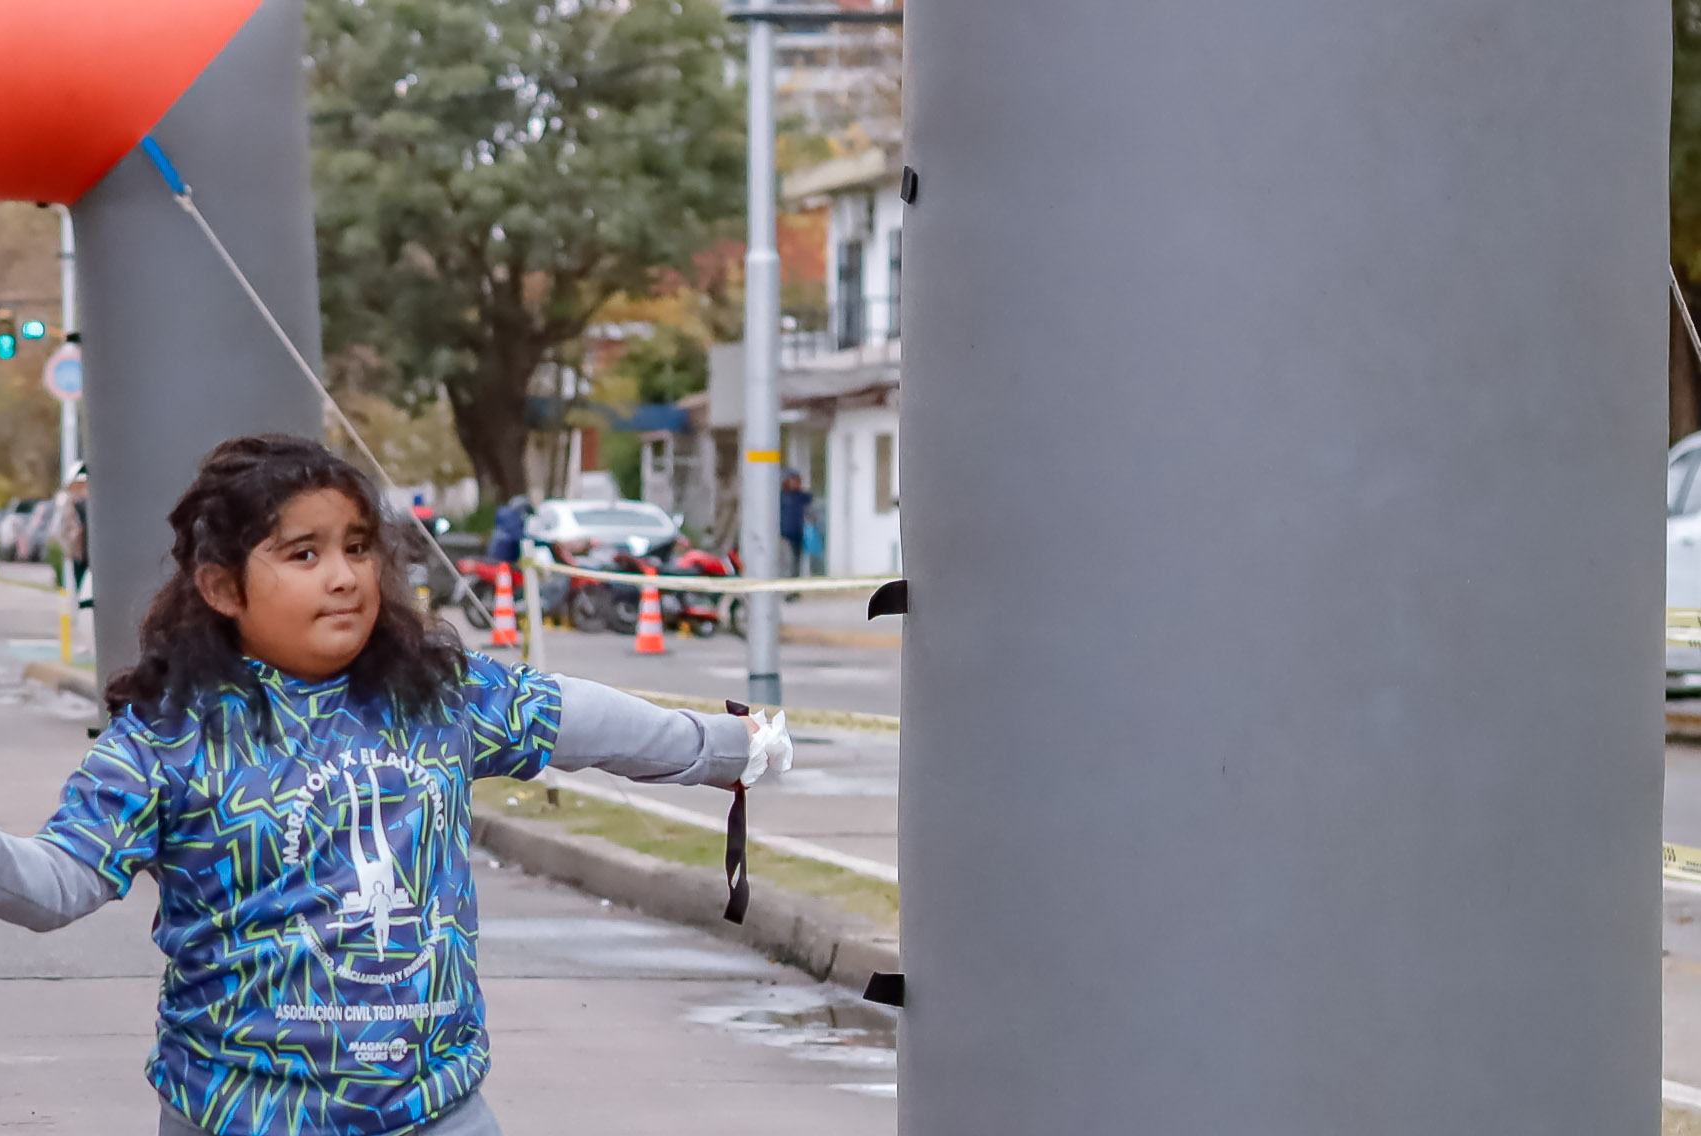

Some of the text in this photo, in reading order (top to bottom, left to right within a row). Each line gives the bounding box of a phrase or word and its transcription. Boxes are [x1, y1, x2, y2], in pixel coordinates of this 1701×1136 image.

[283, 748, 445, 865] MARATÓN X EL AUTISMO
[275, 1001, 343, 1021] ASOCIACIÓN
[344, 1005, 372, 1021] CIVIL
[373, 1004, 394, 1021] TGD
[396, 1003, 429, 1020] PADRES
[349, 1041, 390, 1052] MAGNY
